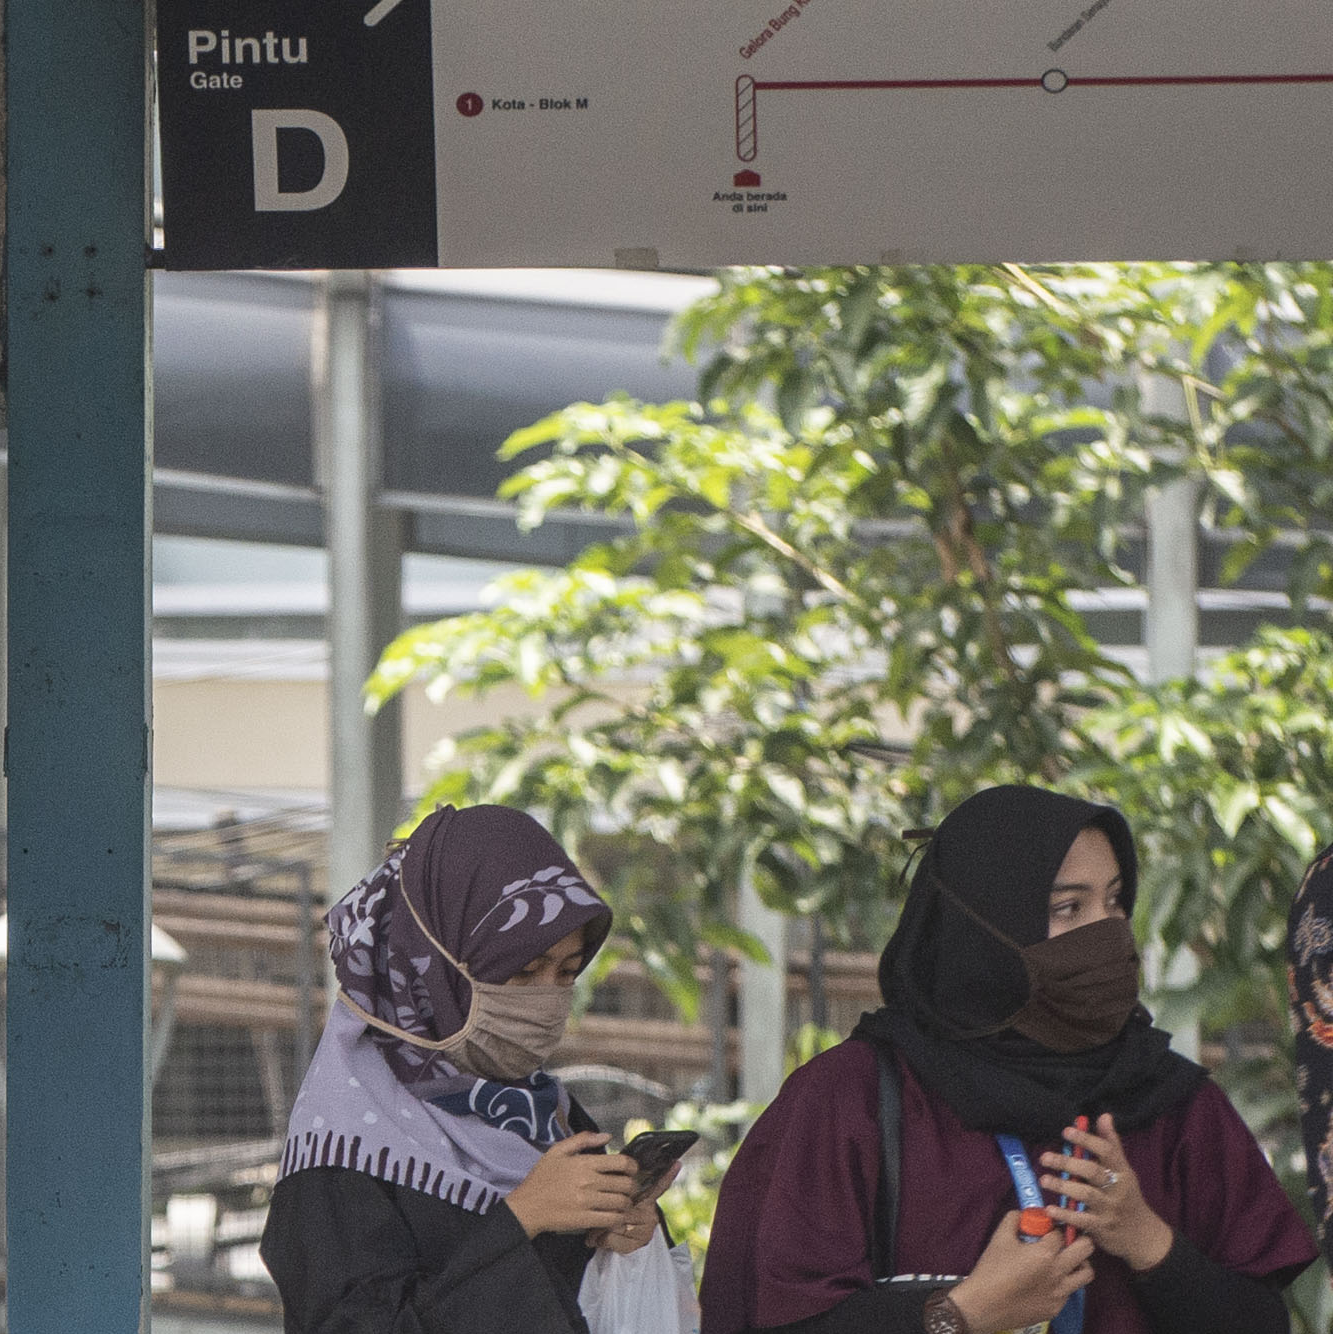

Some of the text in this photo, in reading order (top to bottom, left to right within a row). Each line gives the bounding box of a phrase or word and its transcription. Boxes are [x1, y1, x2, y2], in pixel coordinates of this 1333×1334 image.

[739, 28, 774, 59] Gelora
[768, 4, 801, 31] Bung
[188, 29, 308, 64] Pintu
[190, 71, 243, 89] Gate
[492, 98, 526, 110] Kota
[539, 98, 572, 110] Blok
[576, 98, 589, 110] M
[251, 109, 349, 212] D
[713, 191, 788, 201] Anda berada
[732, 203, 768, 213] di sini
